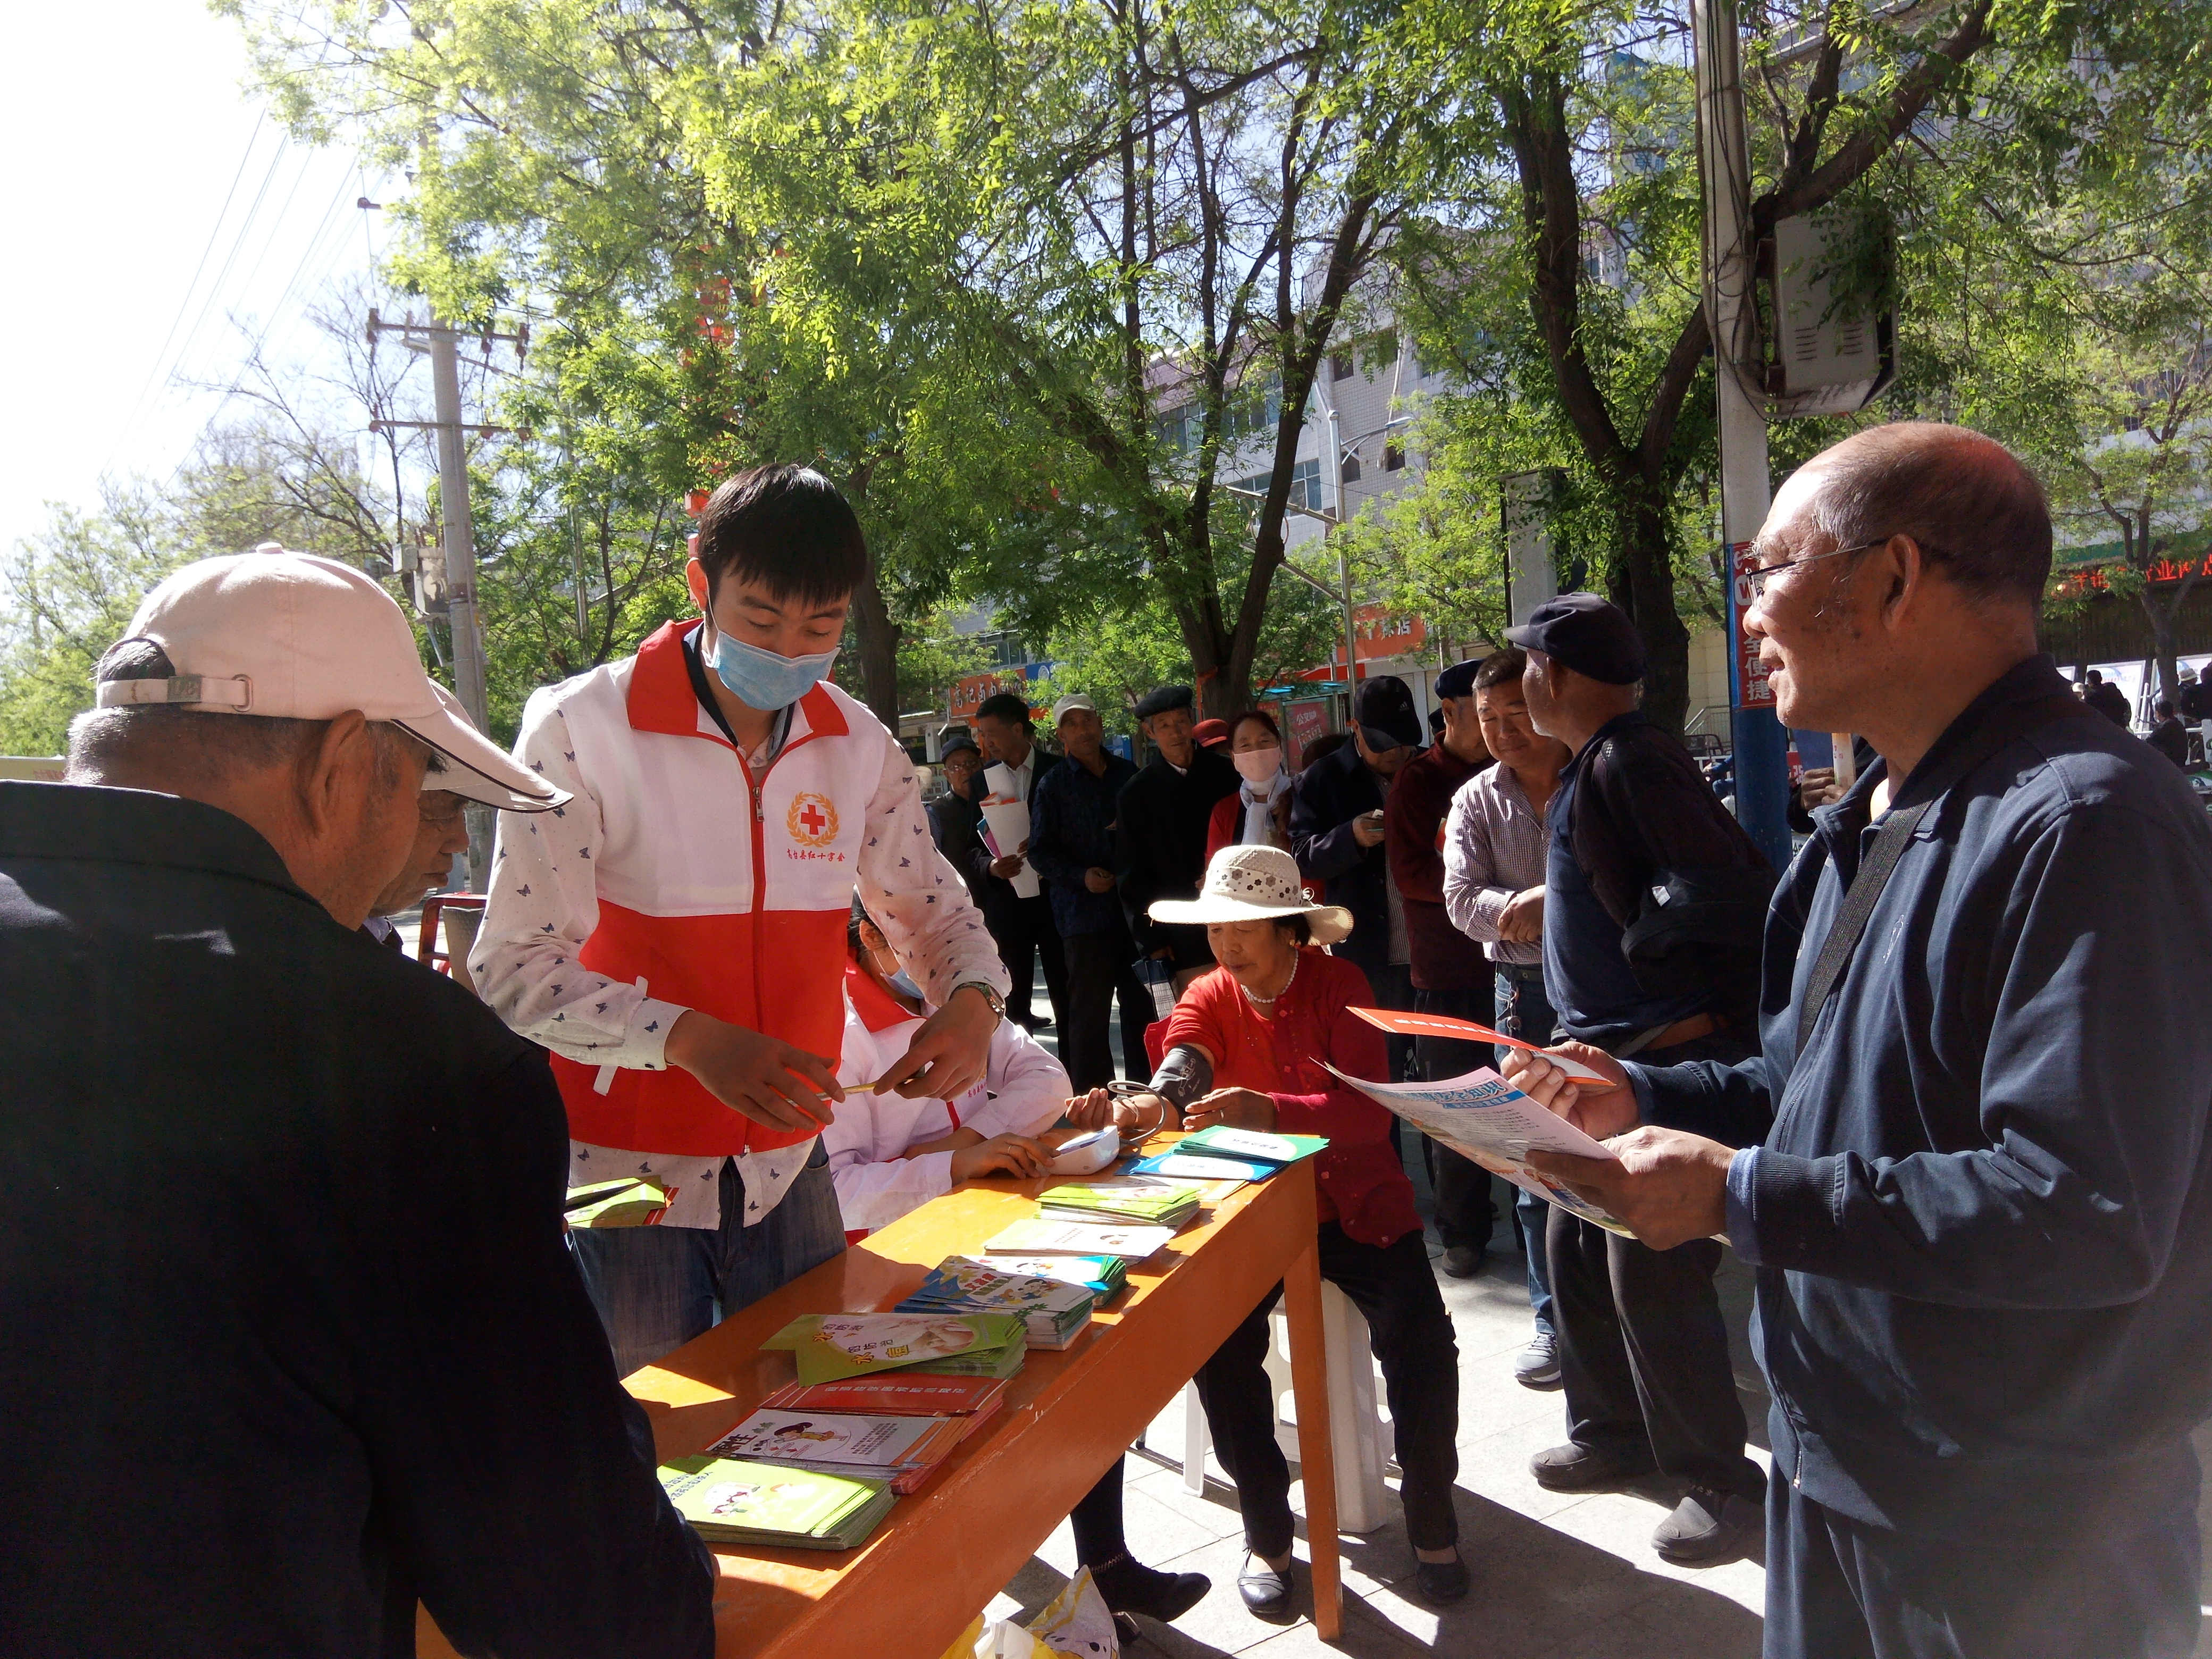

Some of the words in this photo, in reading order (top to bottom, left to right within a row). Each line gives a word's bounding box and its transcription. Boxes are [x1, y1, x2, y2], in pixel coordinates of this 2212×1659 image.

[1744, 636, 1772, 701] 全便捷
[847, 1339, 893, 1353] 的防治
[851, 1345, 909, 1365] 水痘
